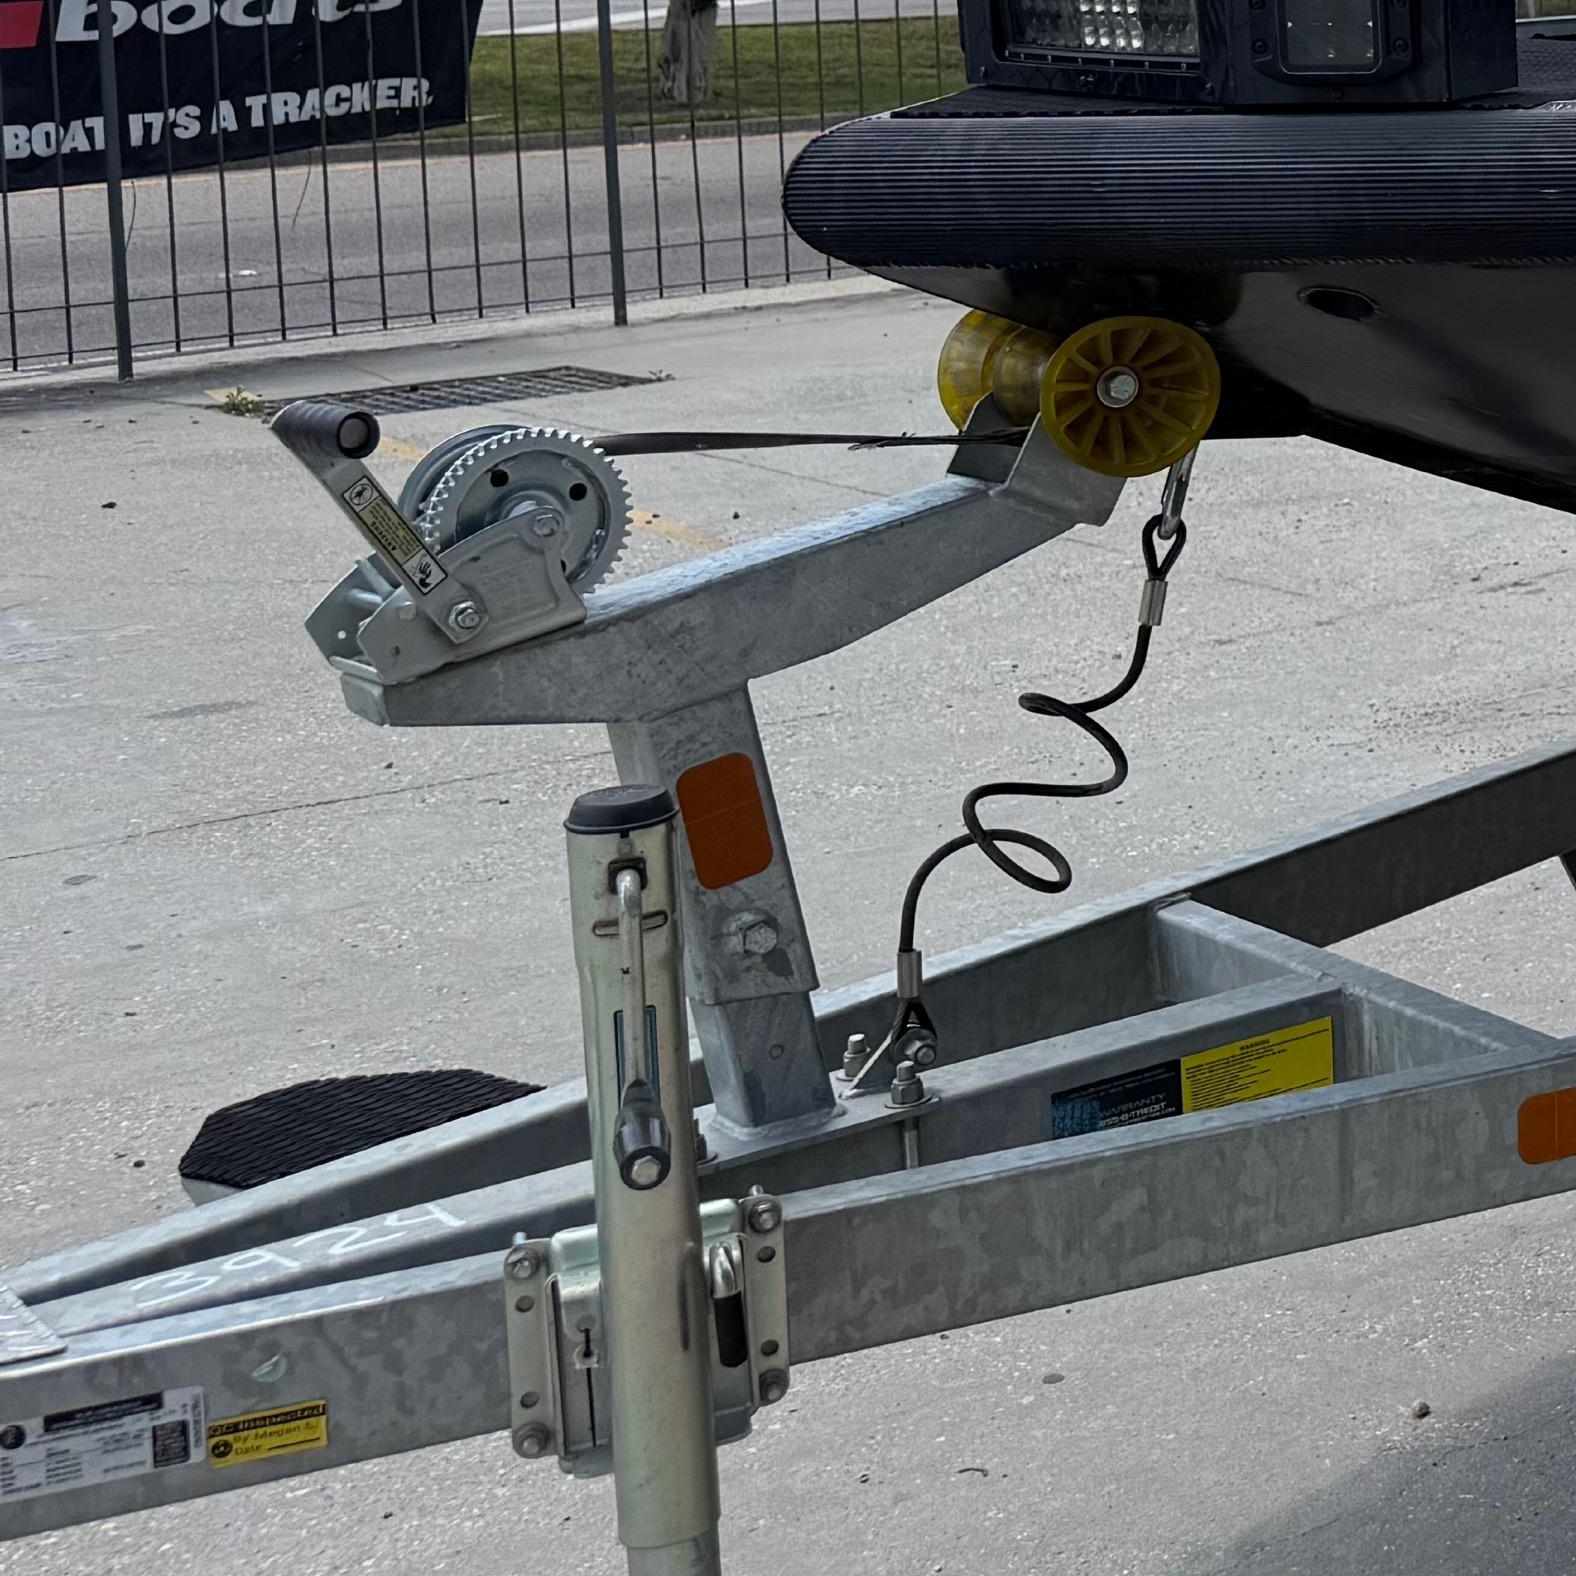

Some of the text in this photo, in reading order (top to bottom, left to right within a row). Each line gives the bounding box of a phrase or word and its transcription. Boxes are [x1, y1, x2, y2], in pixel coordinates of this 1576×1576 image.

[3, 116, 105, 160] BOAT
[129, 105, 201, 149] IT'S
[210, 100, 238, 135] A
